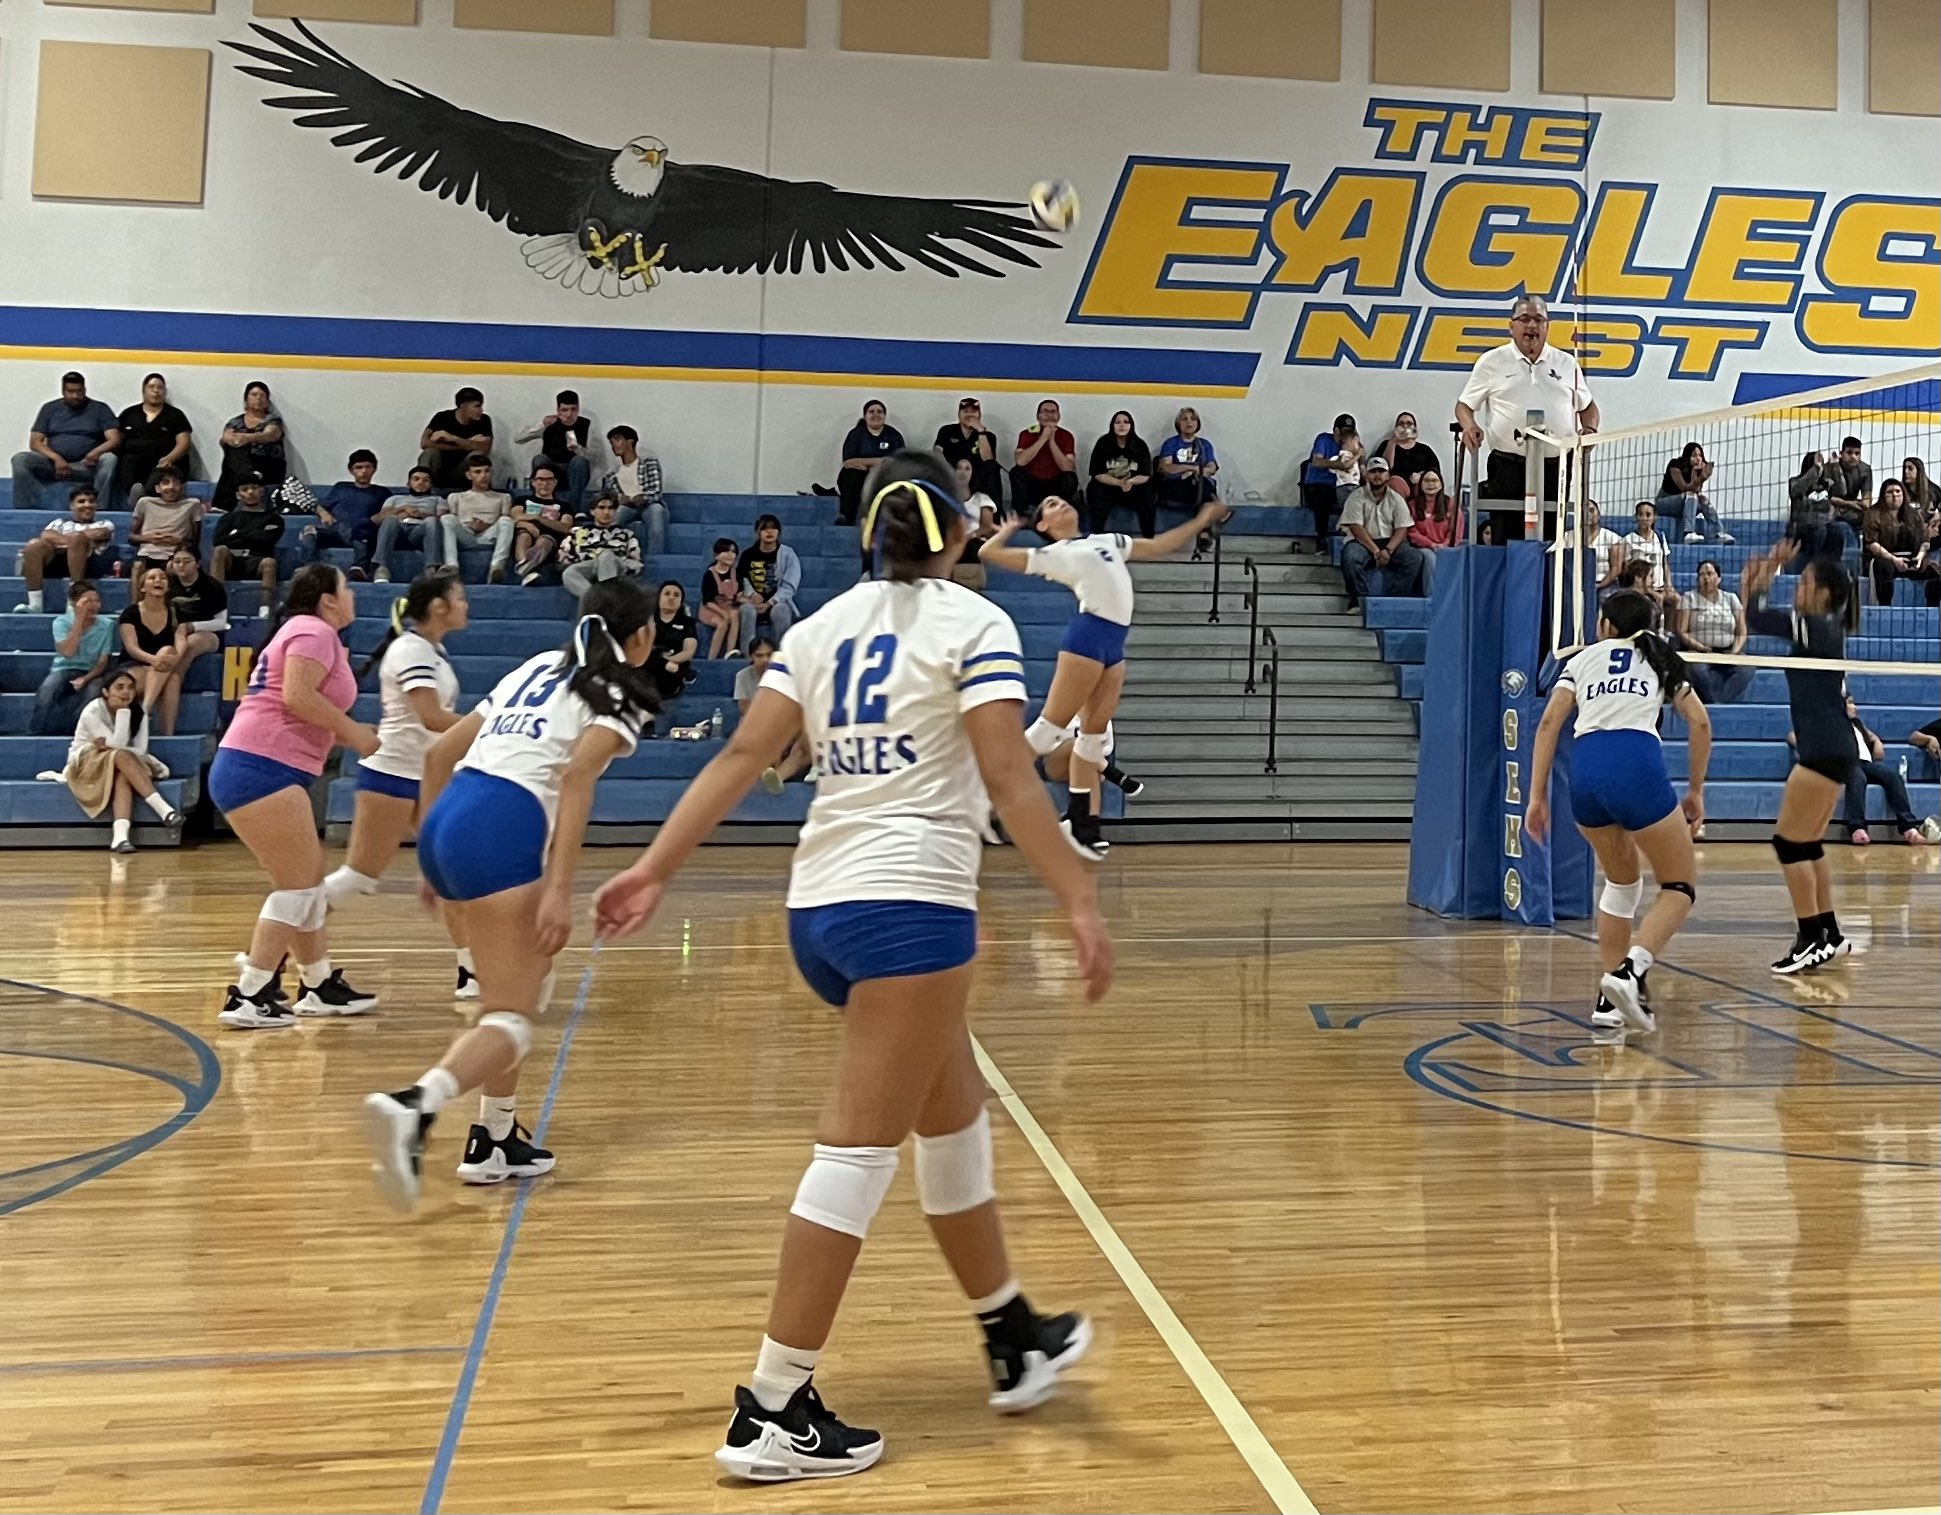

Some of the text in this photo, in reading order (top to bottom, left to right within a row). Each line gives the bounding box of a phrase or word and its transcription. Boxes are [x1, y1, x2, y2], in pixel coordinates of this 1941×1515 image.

[1363, 98, 1602, 171] THE
[1065, 155, 1941, 357] EAGLES
[1284, 302, 1770, 381] NEST
[504, 664, 559, 708] 13
[829, 634, 898, 727] 12
[1587, 678, 1649, 700] EAGLES
[1608, 648, 1633, 675] 9
[480, 713, 548, 739] AGLES
